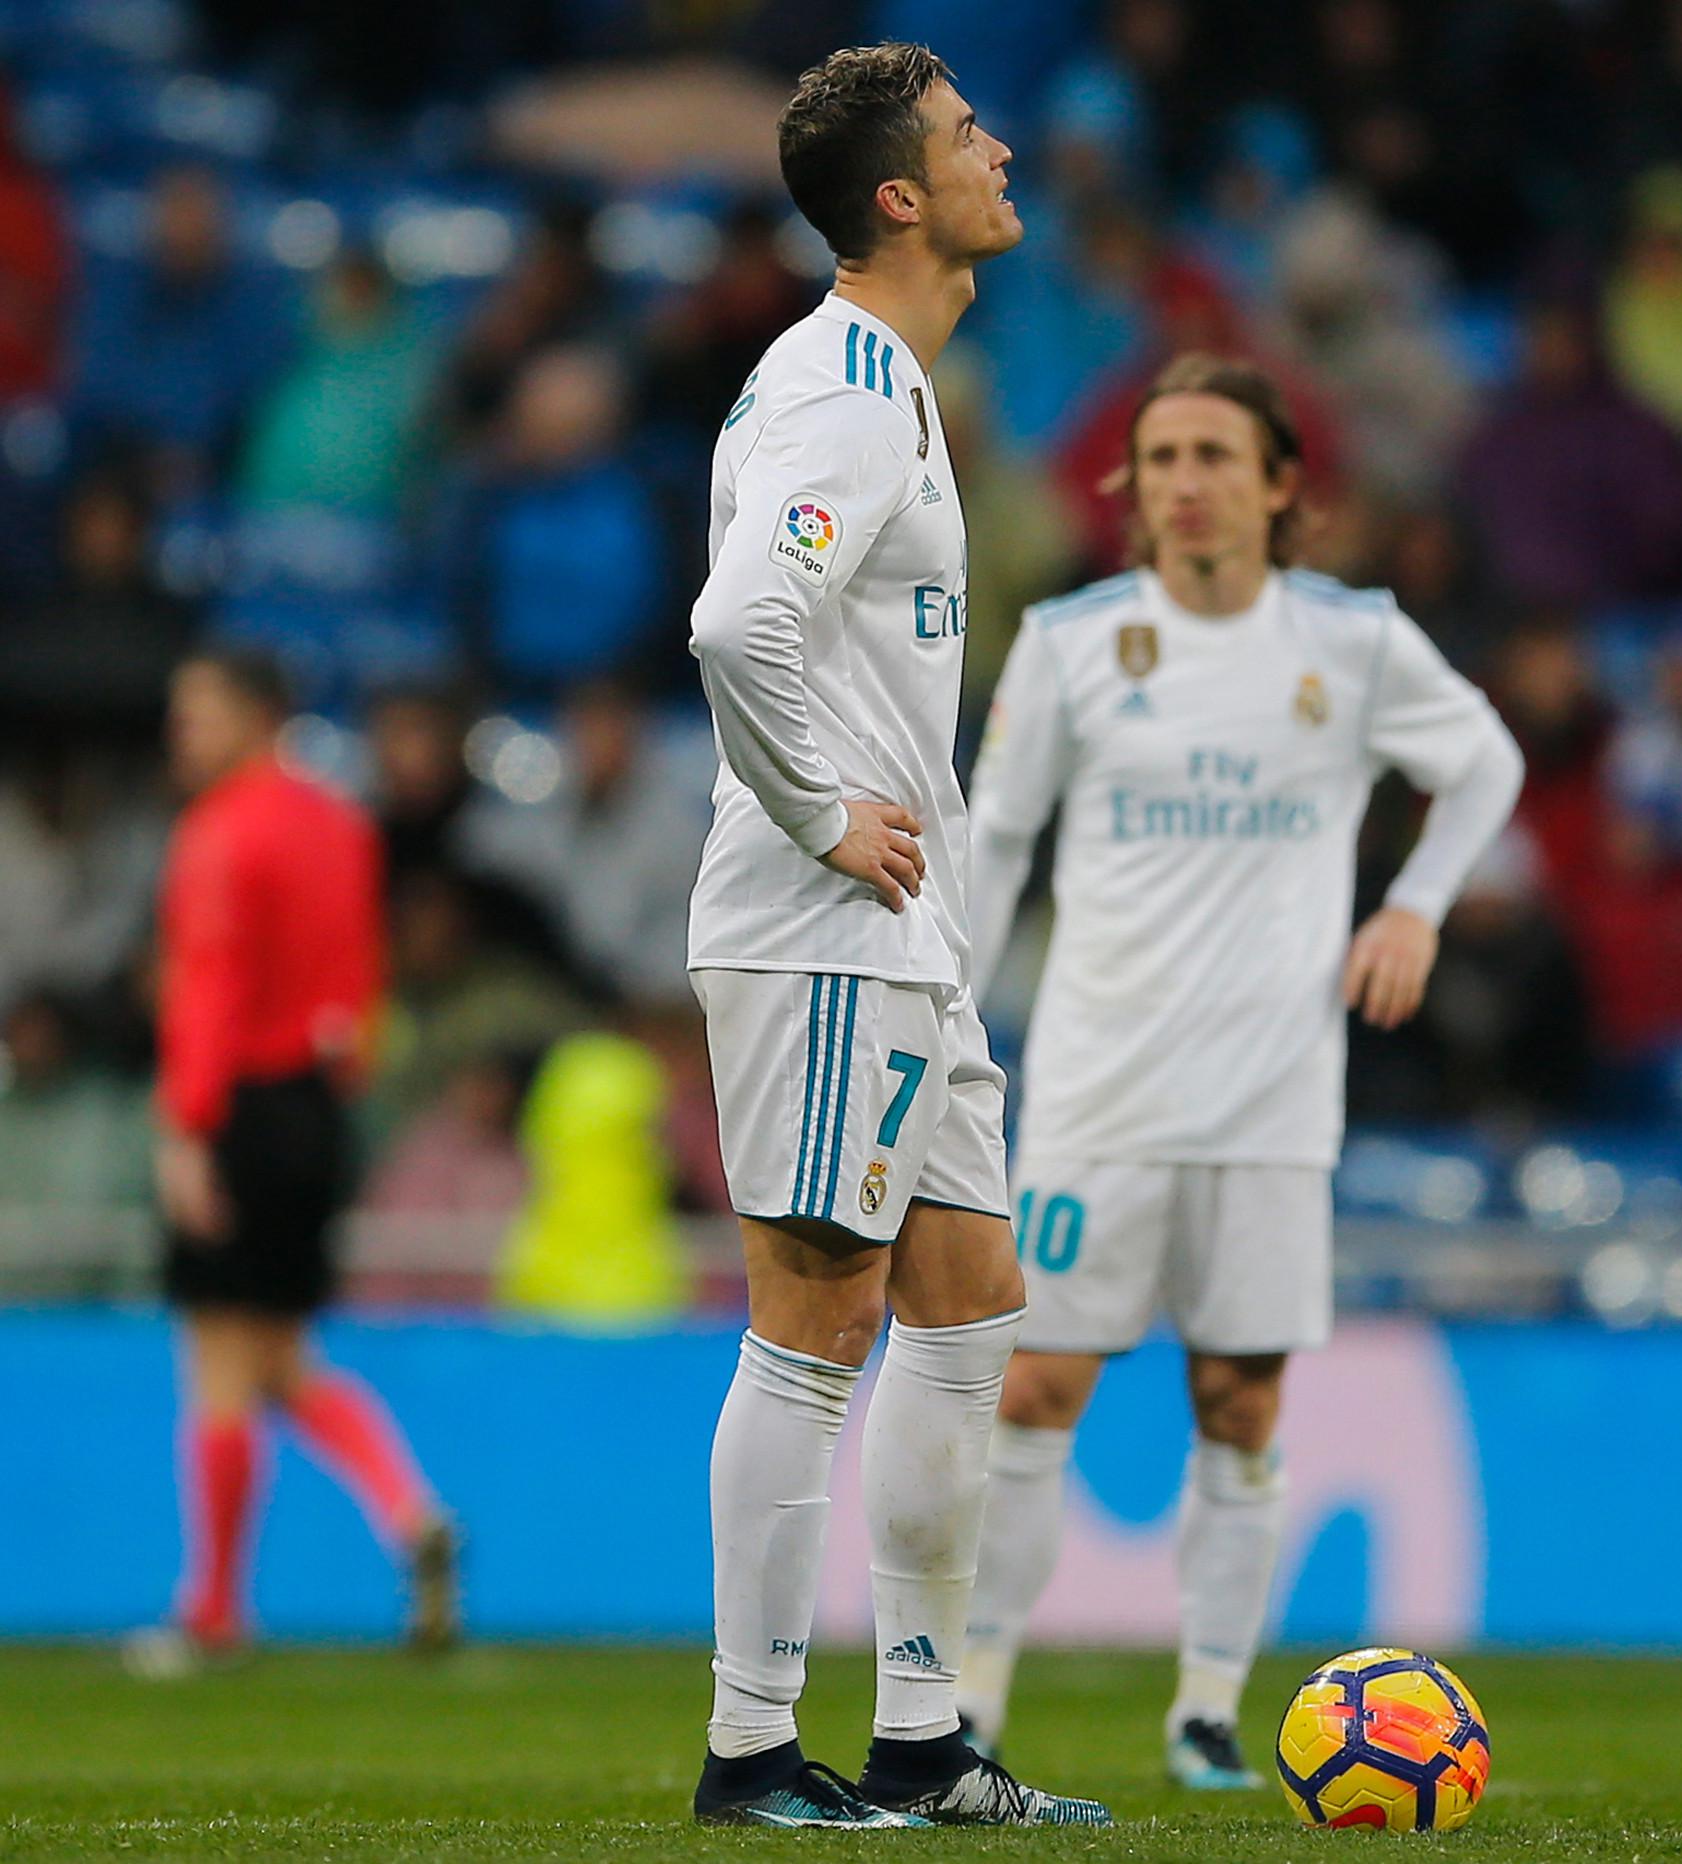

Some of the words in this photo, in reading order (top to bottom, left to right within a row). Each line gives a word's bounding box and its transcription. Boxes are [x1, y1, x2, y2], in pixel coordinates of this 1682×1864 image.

[777, 541, 824, 575] LaLiga
[1188, 747, 1258, 786] Fly
[1112, 789, 1320, 840] Emirates
[876, 1049, 928, 1149] 7
[1016, 1190, 1084, 1273] 10
[885, 1650, 943, 1672] adidas
[909, 1800, 935, 1816] CR7
